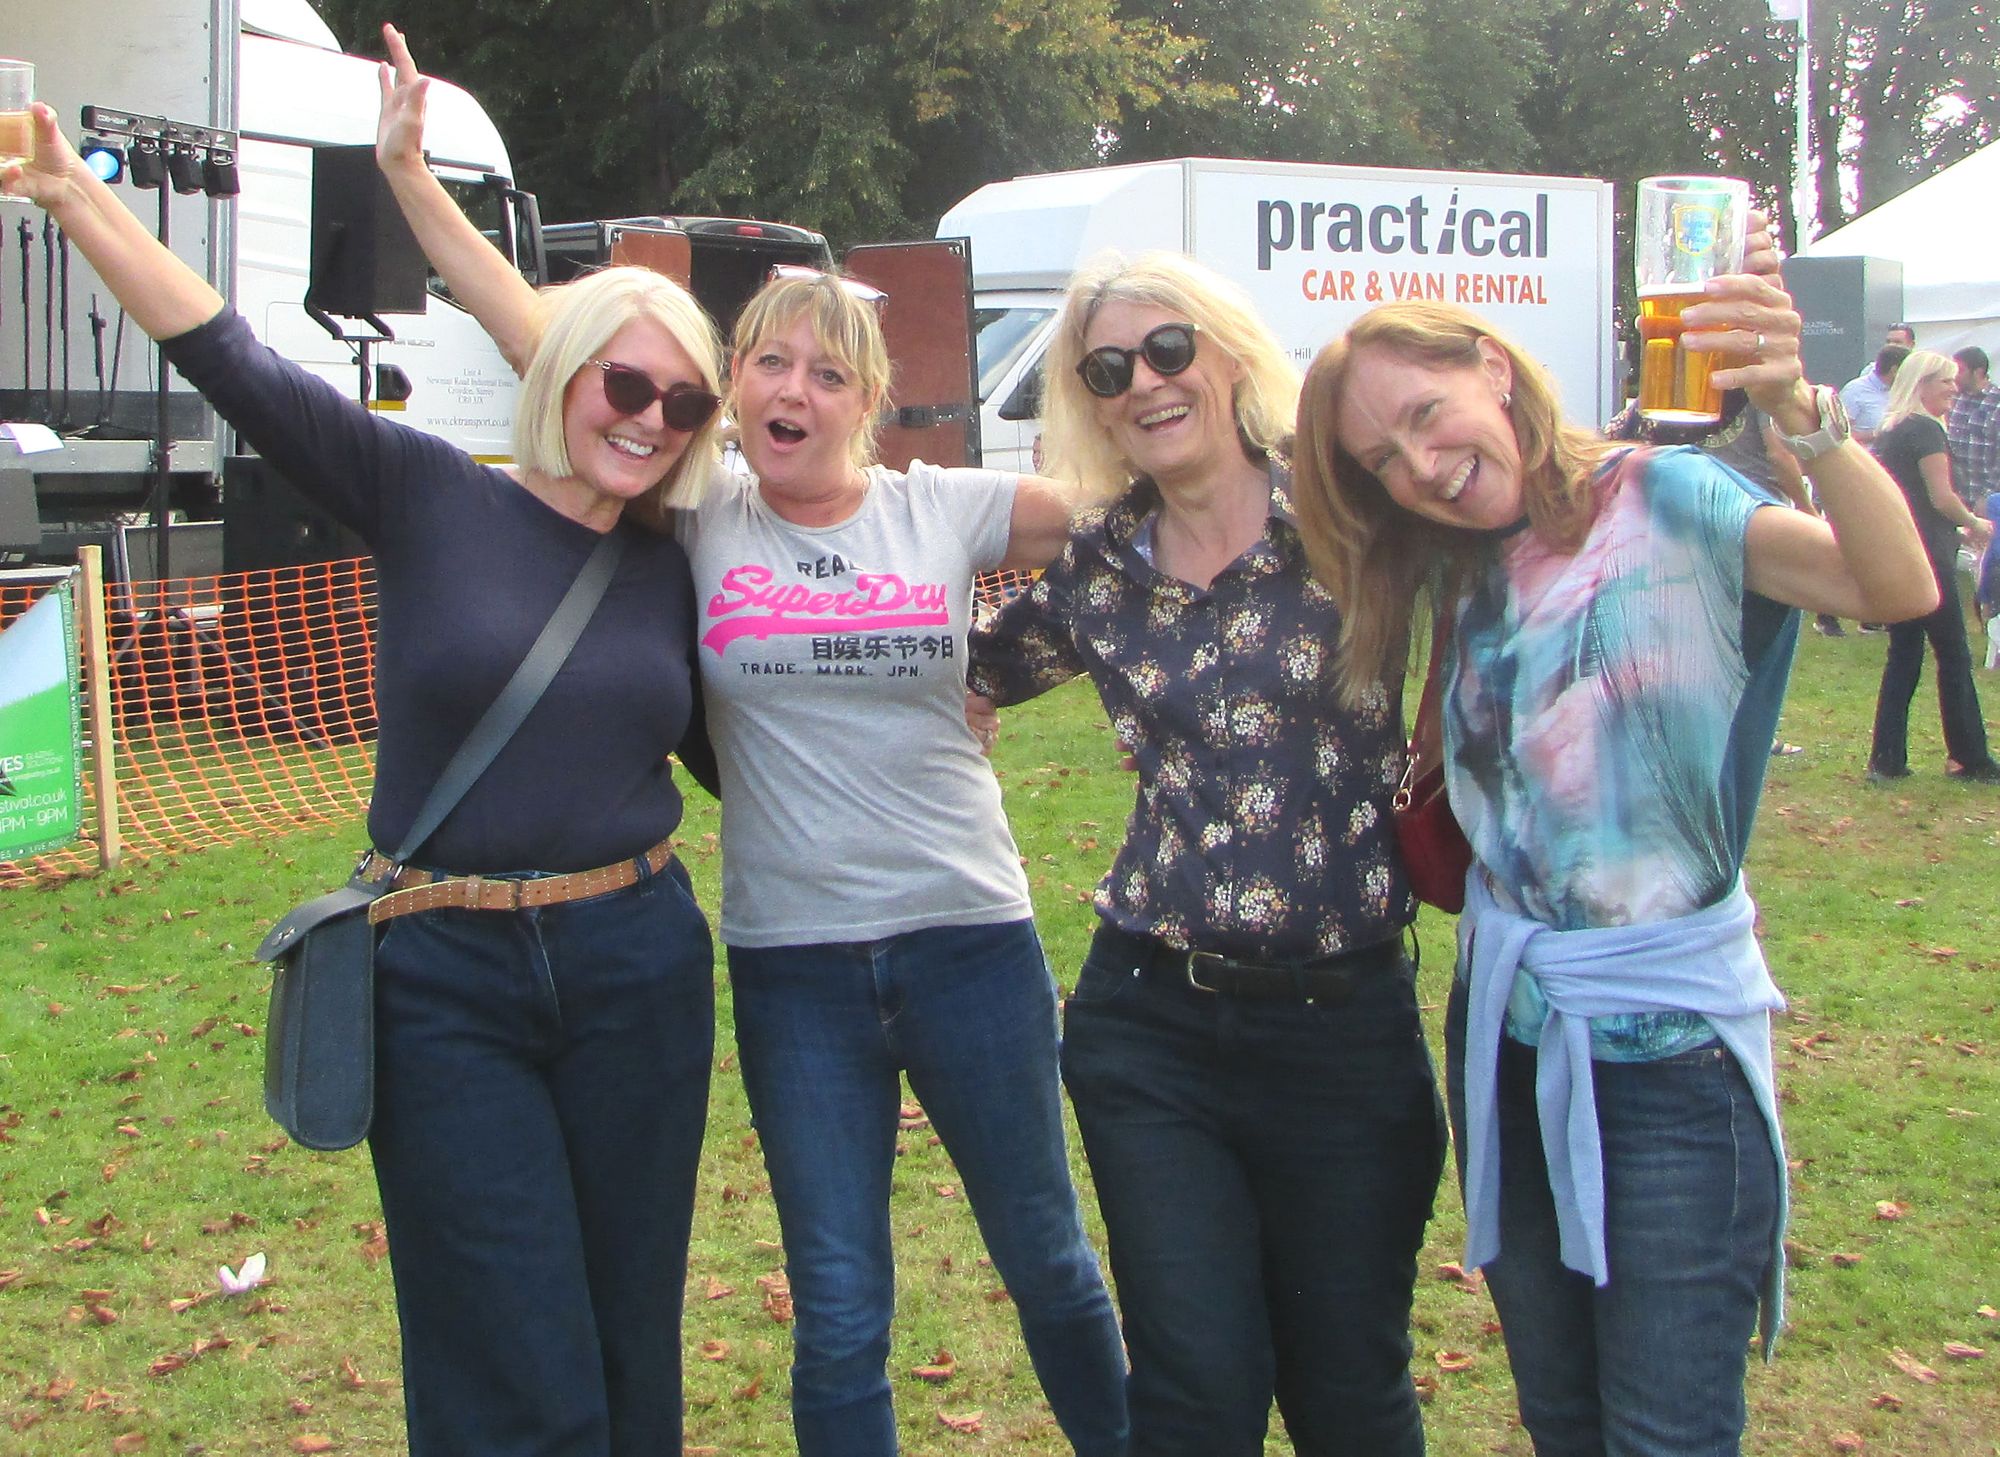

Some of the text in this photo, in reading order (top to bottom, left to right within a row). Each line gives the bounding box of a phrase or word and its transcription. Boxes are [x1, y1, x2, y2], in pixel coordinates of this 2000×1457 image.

[1257, 187, 1548, 270] practical
[1302, 269, 1548, 304] CAR & VAN RENTAL
[1294, 347, 1311, 359] Hill
[797, 554, 865, 579] REAL
[37, 806, 67, 826] 9PM
